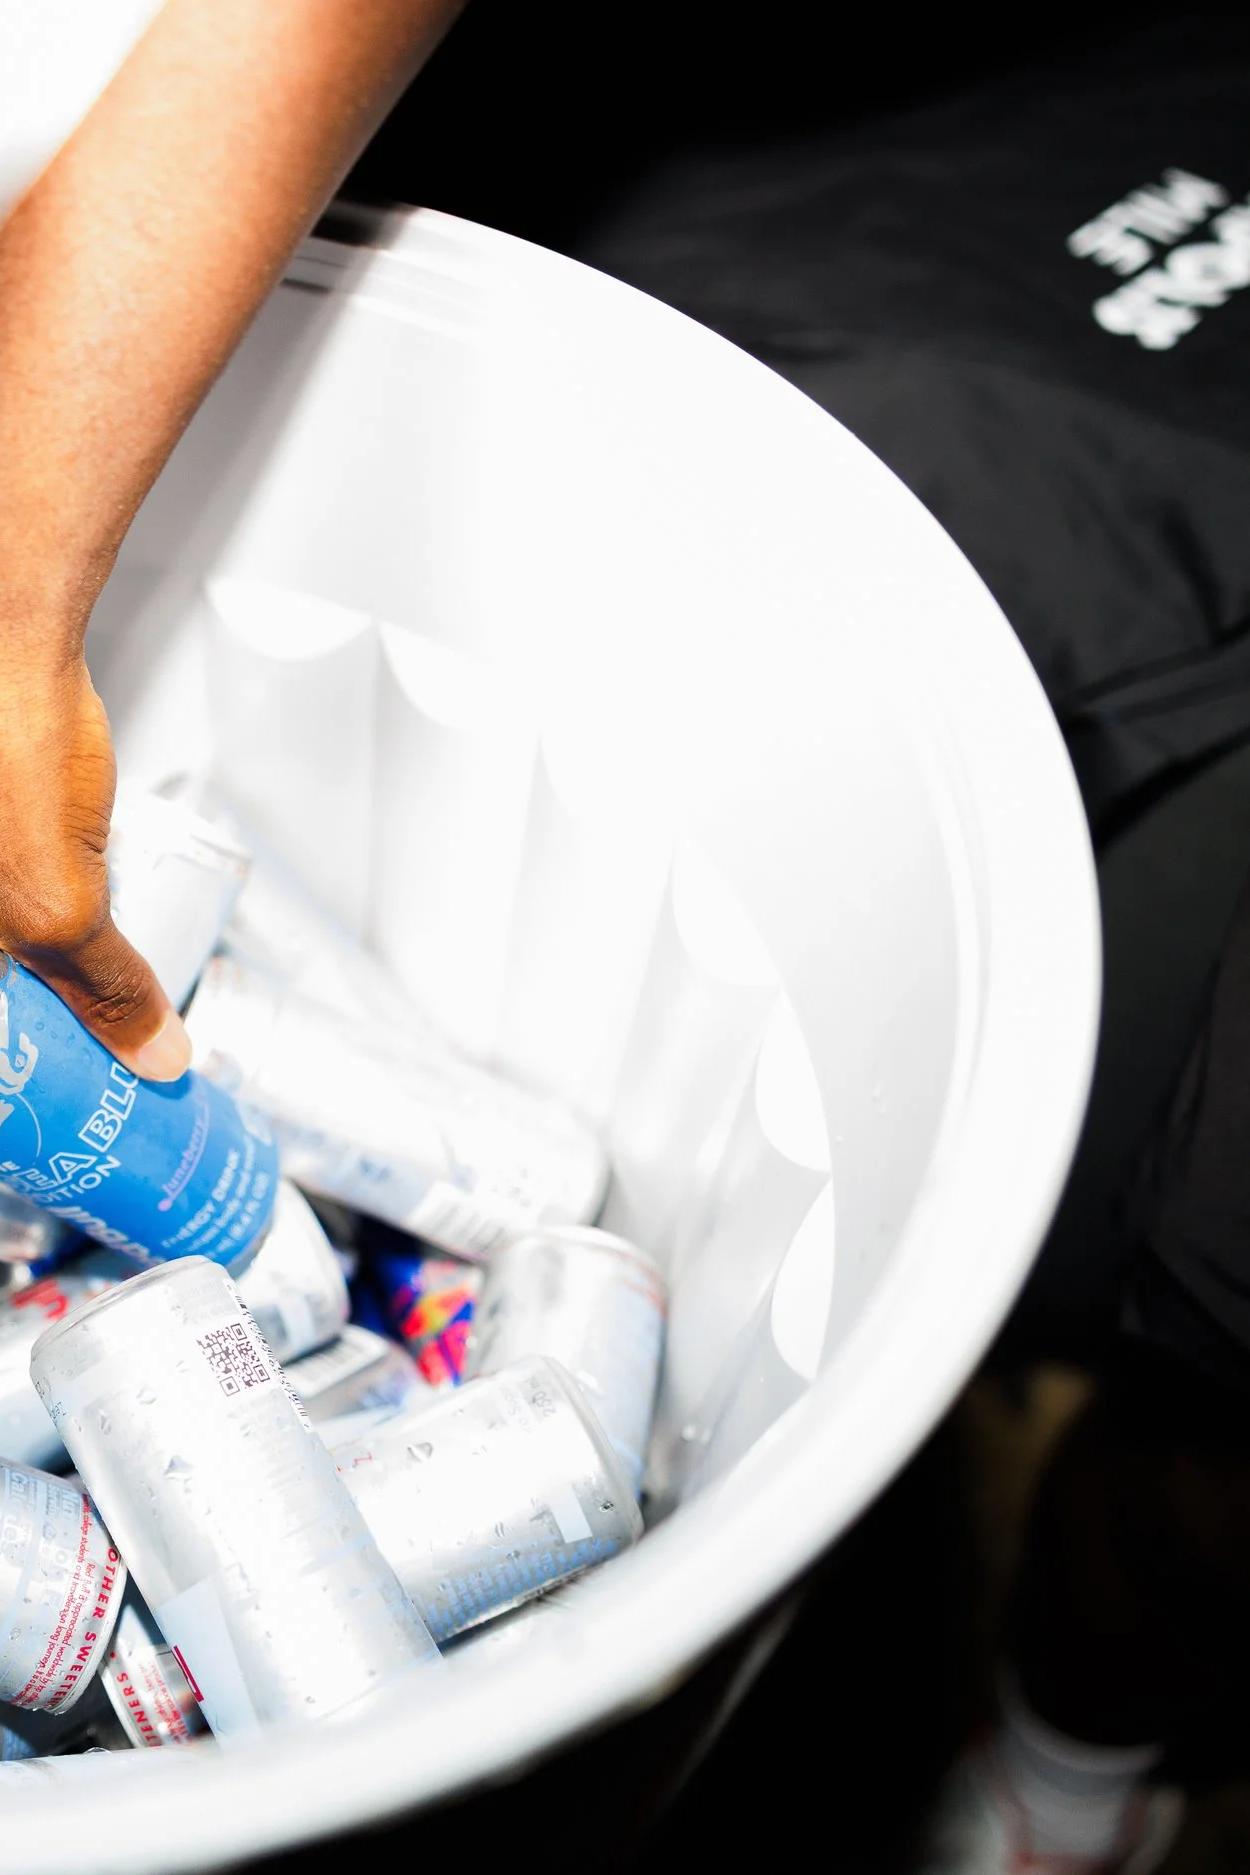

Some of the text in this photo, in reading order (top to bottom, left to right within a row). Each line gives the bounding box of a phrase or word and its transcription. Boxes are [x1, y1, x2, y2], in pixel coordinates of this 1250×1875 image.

[78, 1060, 140, 1153] BLU
[36, 1153, 122, 1209] DITION
[76, 1536, 90, 1563] students
[83, 1562, 95, 1578] Red
[44, 1549, 119, 1709] OTHER SWEETEN
[49, 1624, 65, 1641] long
[61, 1601, 84, 1646] appreciated
[115, 1671, 161, 1745] TENERS
